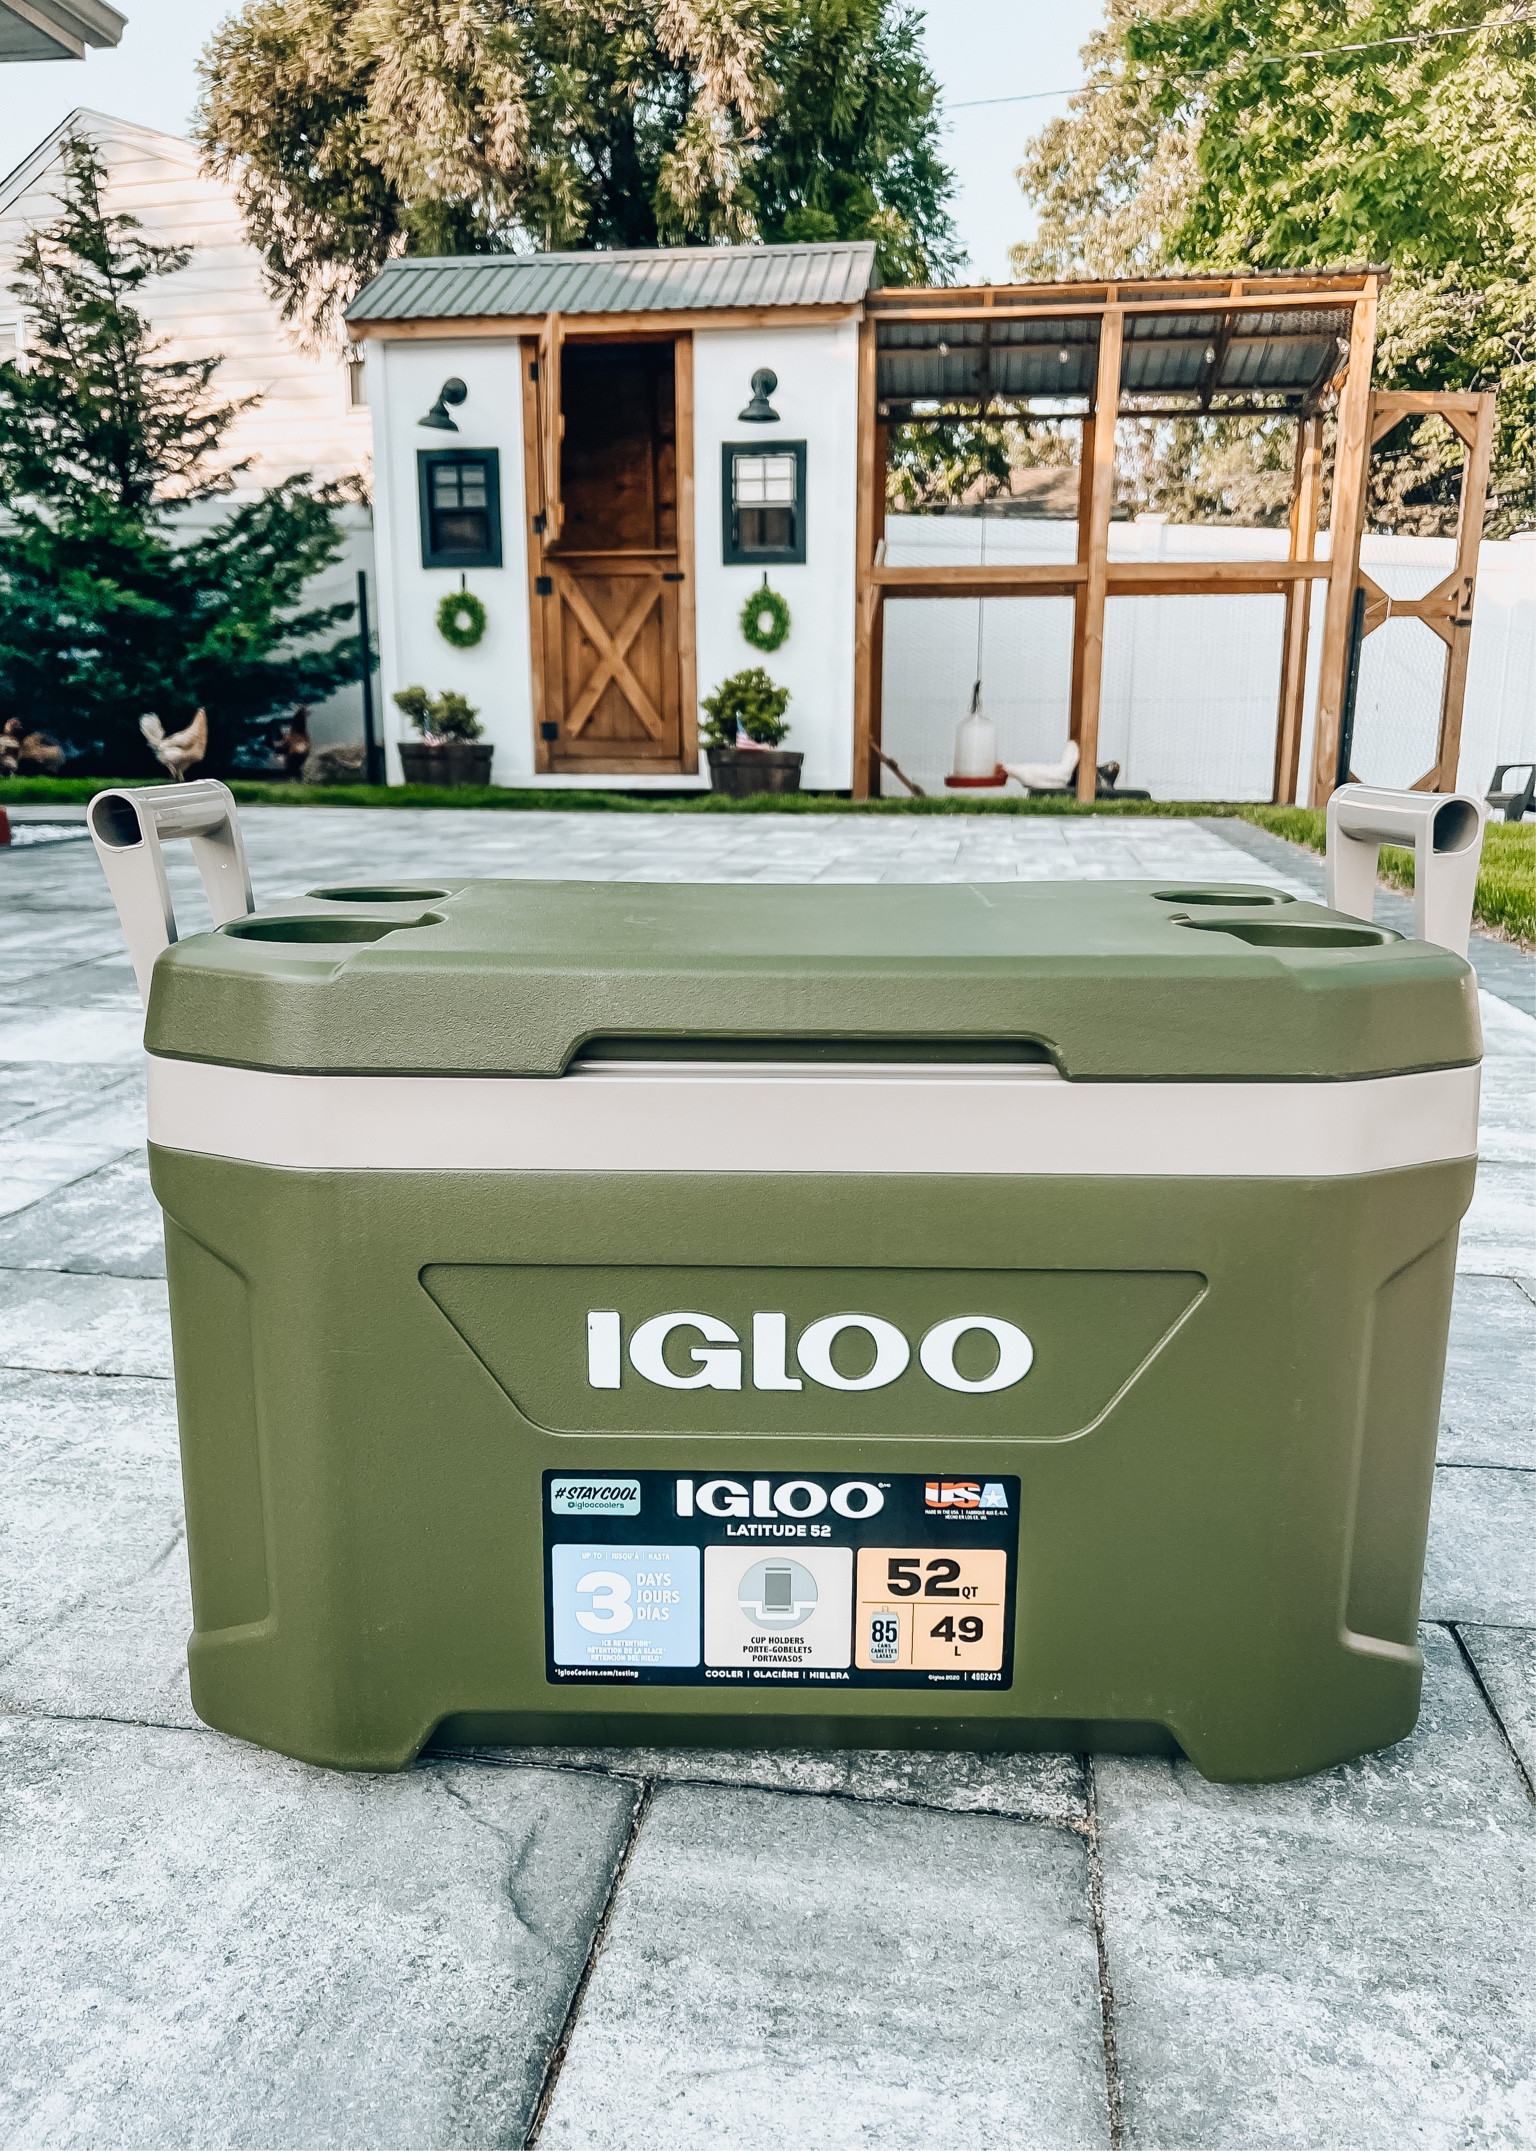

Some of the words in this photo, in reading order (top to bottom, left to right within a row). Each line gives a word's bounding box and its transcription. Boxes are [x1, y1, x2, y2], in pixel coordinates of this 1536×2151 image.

[587, 1311, 1034, 1393] IGLOO
[676, 1479, 885, 1519] IGLOO
[925, 1482, 1009, 1508] USA
[727, 1525, 806, 1537] LATITUDE
[811, 1525, 831, 1537] 52
[593, 1552, 602, 1560] TO
[611, 1551, 639, 1561] JUSQU'À
[637, 1573, 672, 1587] DAYS
[887, 1558, 961, 1597] 52
[637, 1590, 680, 1604] JOURS
[962, 1587, 978, 1599] QT
[575, 1571, 634, 1634] 3
[637, 1604, 670, 1620] DÍAS
[872, 1620, 898, 1643] 85
[930, 1616, 984, 1643] 49
[743, 1645, 812, 1653] PORTE-GOBELETS
[954, 1646, 961, 1656] L
[705, 1670, 743, 1678] COOLER
[753, 1669, 799, 1679] GLACIÈRE
